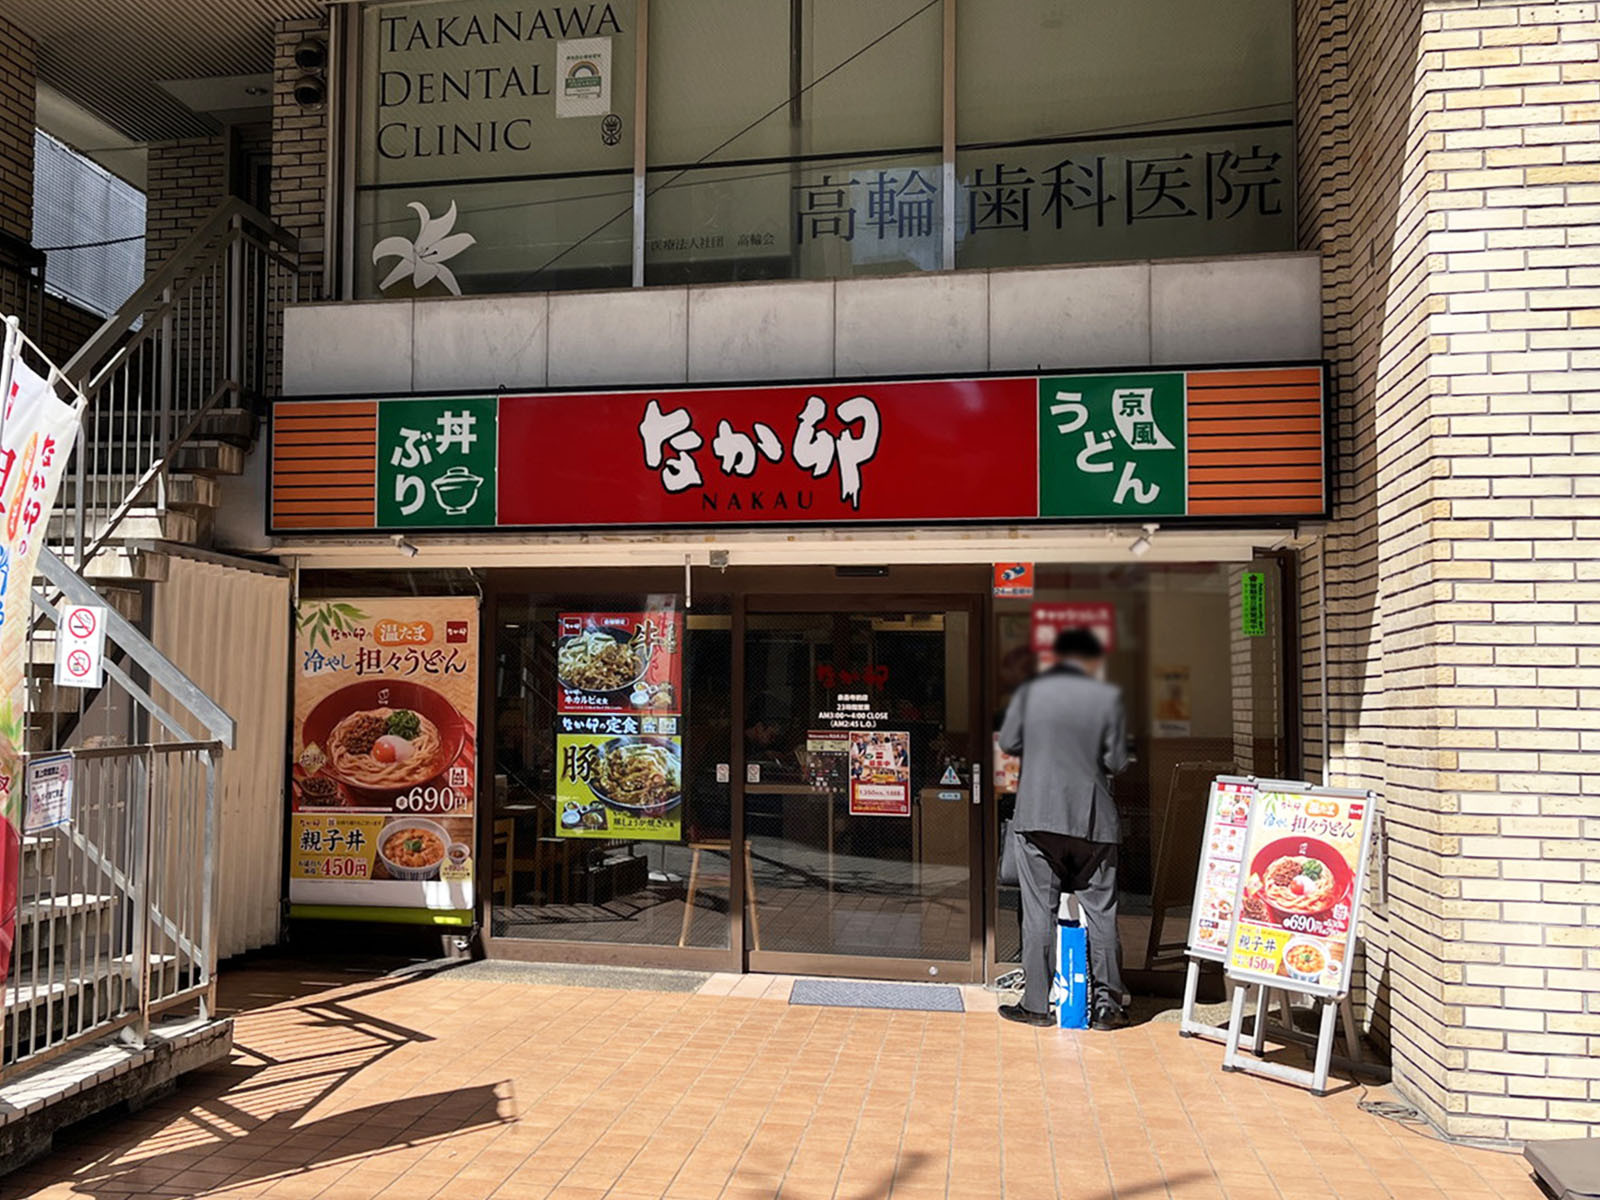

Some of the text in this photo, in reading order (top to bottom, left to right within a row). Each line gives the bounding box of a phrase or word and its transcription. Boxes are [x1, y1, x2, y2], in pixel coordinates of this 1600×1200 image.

[380, 4, 625, 54] TAKANAWA
[379, 64, 551, 108] DENTAL
[377, 118, 532, 161] CLINIC
[794, 144, 1283, 244] 高輪歯科医院
[1118, 391, 1158, 446] 京風
[638, 394, 882, 510] なか卯
[1050, 391, 1160, 505] うどん
[702, 491, 814, 510] NAKAU
[380, 623, 427, 642] 温たま
[304, 647, 468, 676] 冷やし 担々うどん
[867, 711, 889, 720] CLOSE
[562, 743, 601, 784] 豚
[300, 828, 366, 852] 親子丼
[321, 857, 367, 877] 450円
